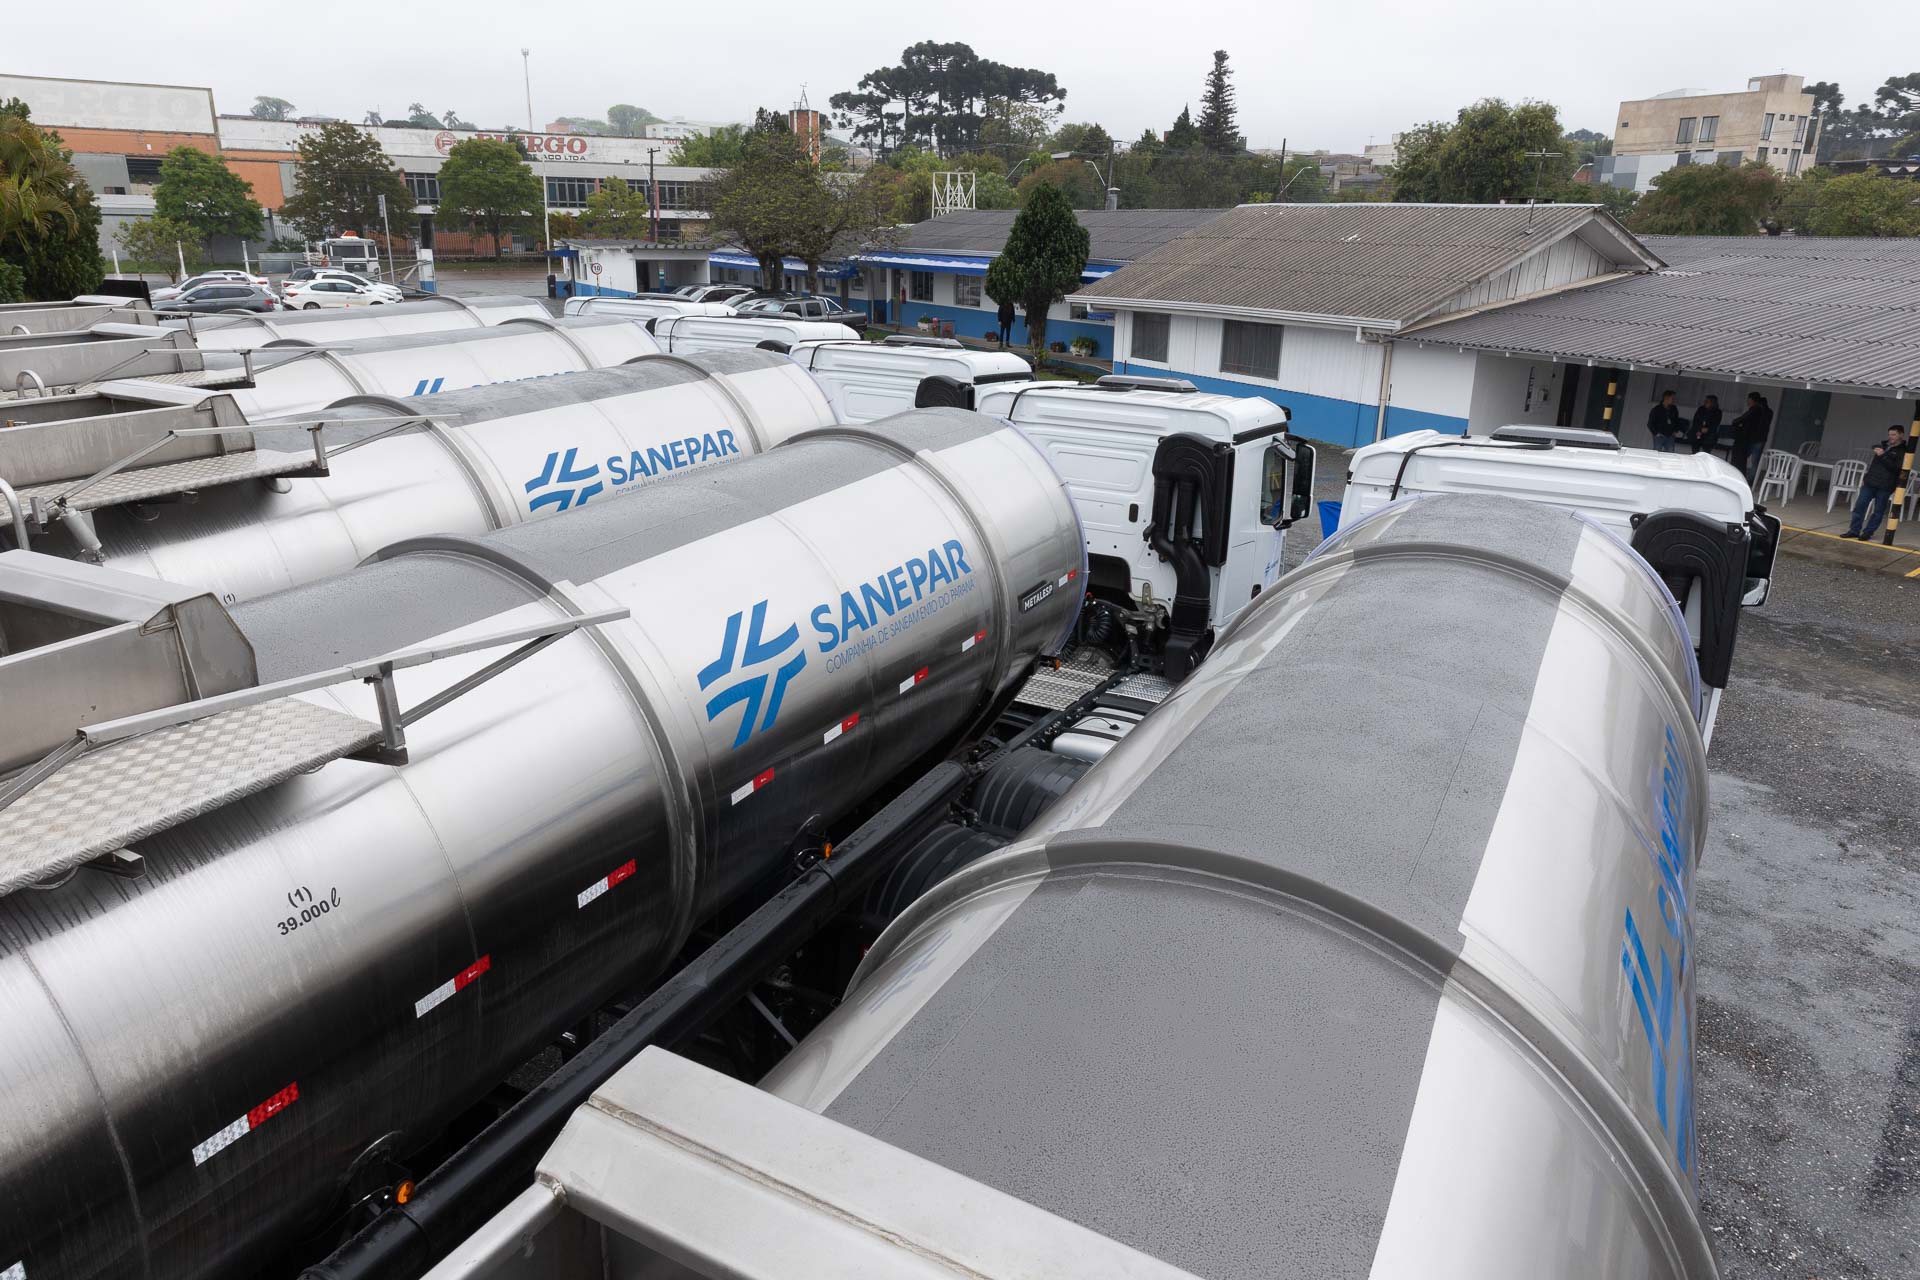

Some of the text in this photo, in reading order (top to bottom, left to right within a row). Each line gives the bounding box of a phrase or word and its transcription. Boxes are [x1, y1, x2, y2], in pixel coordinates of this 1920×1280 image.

[607, 429, 739, 486] SANEPAR
[223, 593, 236, 605] (1)
[810, 539, 972, 653] SANEPAR
[1024, 584, 1053, 611] METALESP
[825, 633, 878, 674] COMPANHIA
[878, 627, 890, 644] DE
[890, 600, 938, 636] SANEAMENTO
[938, 592, 950, 609] DO
[288, 886, 312, 908] (1)
